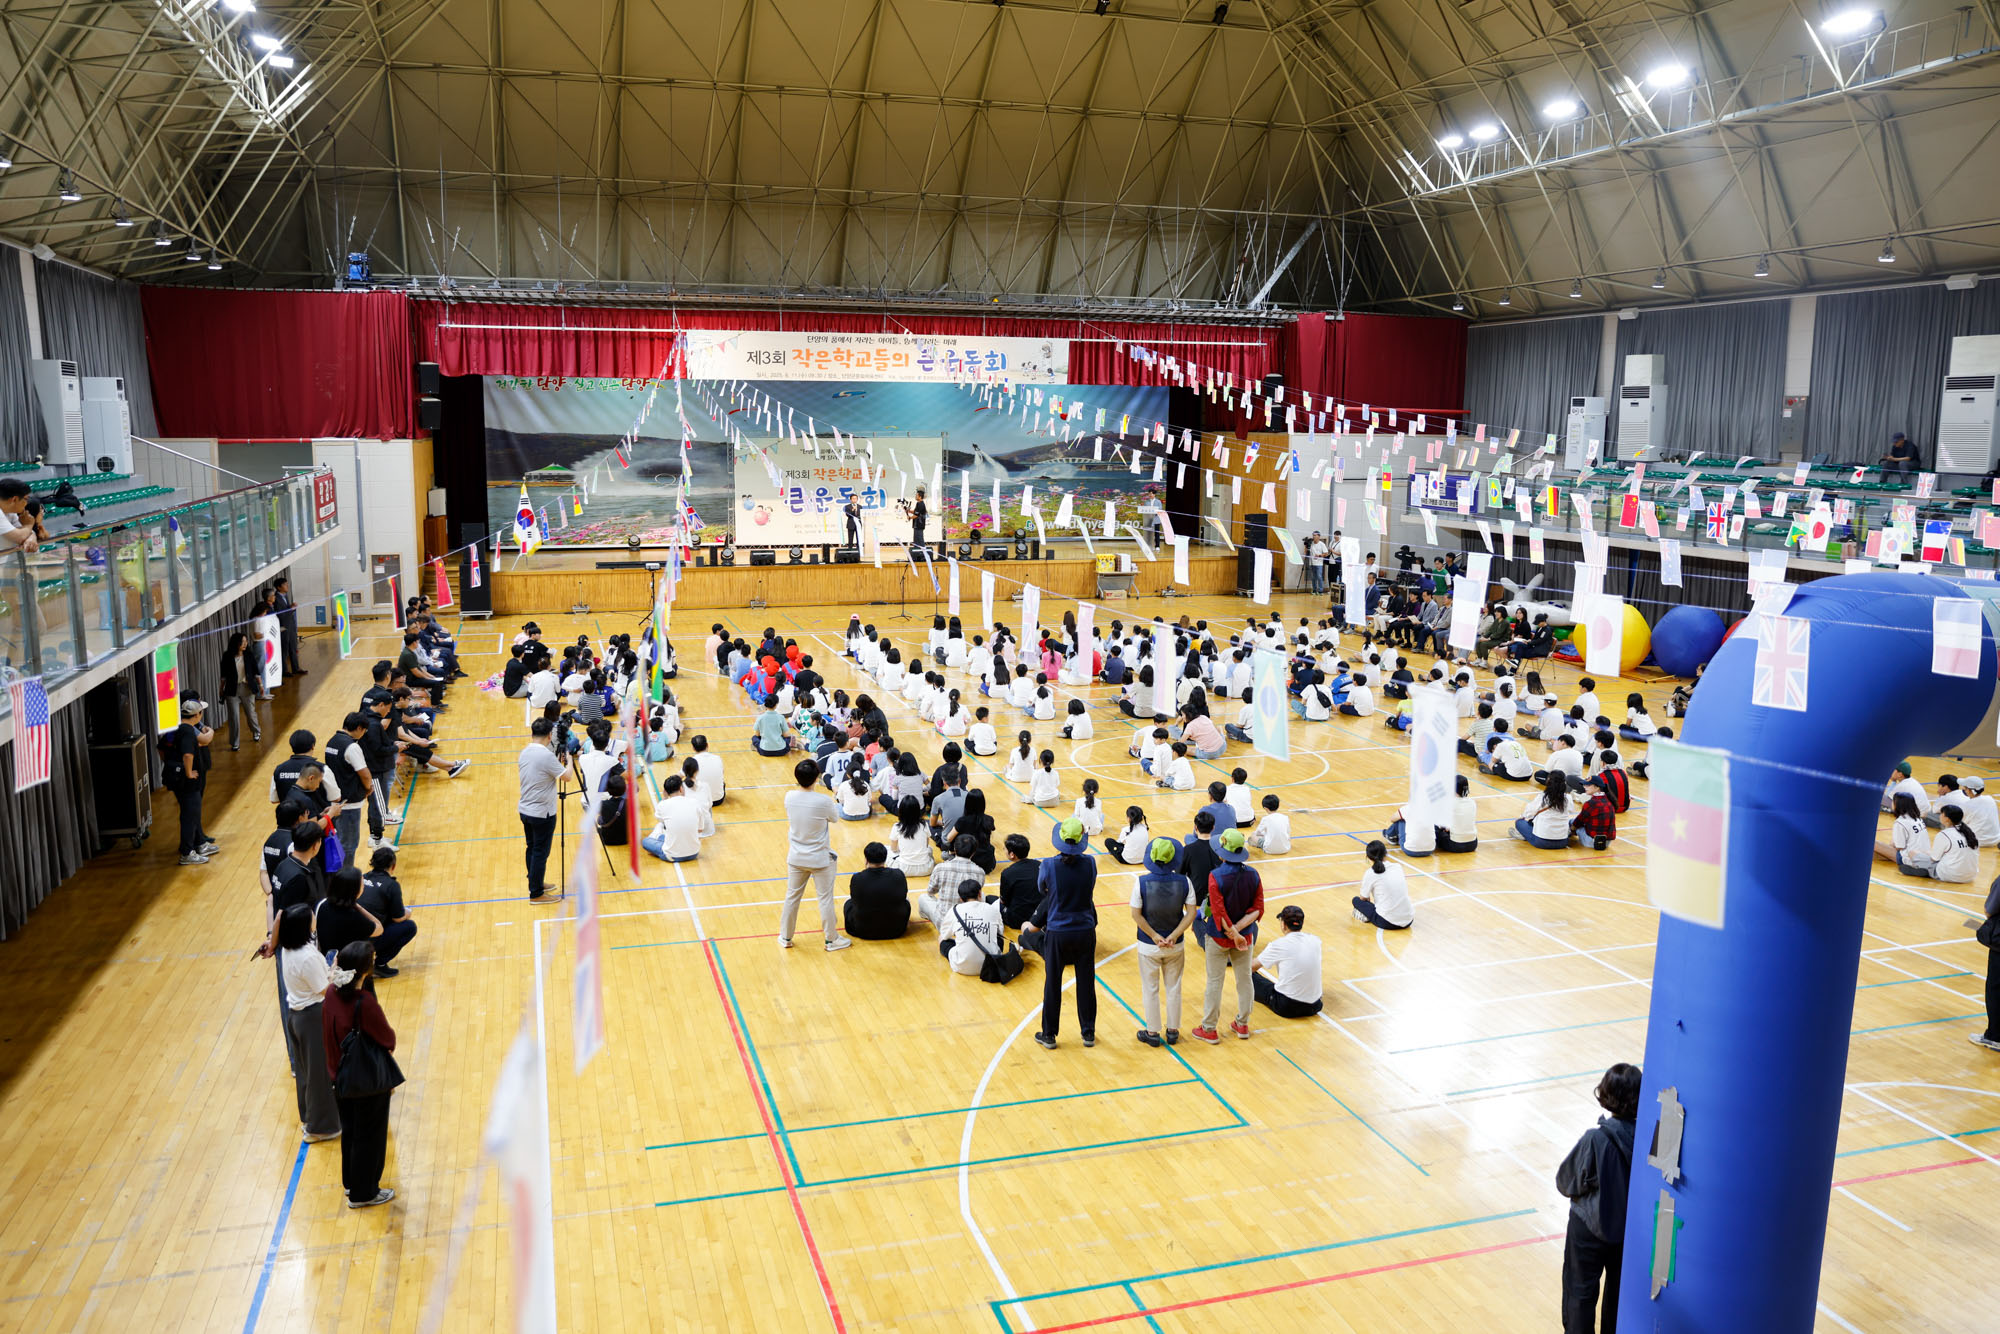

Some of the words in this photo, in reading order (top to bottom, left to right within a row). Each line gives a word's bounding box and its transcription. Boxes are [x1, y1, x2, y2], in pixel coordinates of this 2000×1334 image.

[807, 335, 828, 344] 단양의
[831, 336, 852, 344] 품에서
[854, 336, 875, 344] 자라는
[903, 337, 918, 345] 함께
[943, 338, 957, 346] 미래
[746, 350, 786, 366] 제3회
[791, 347, 910, 372] 작은학교들의
[916, 349, 935, 372] 큰
[941, 349, 1007, 373] 운동회
[496, 378, 534, 391] 건강한
[537, 376, 567, 392] 단양
[574, 378, 595, 392] 살고
[621, 377, 650, 392] 단양
[785, 469, 810, 480] 제3회
[784, 487, 805, 514] 큰
[837, 759, 851, 772] 10
